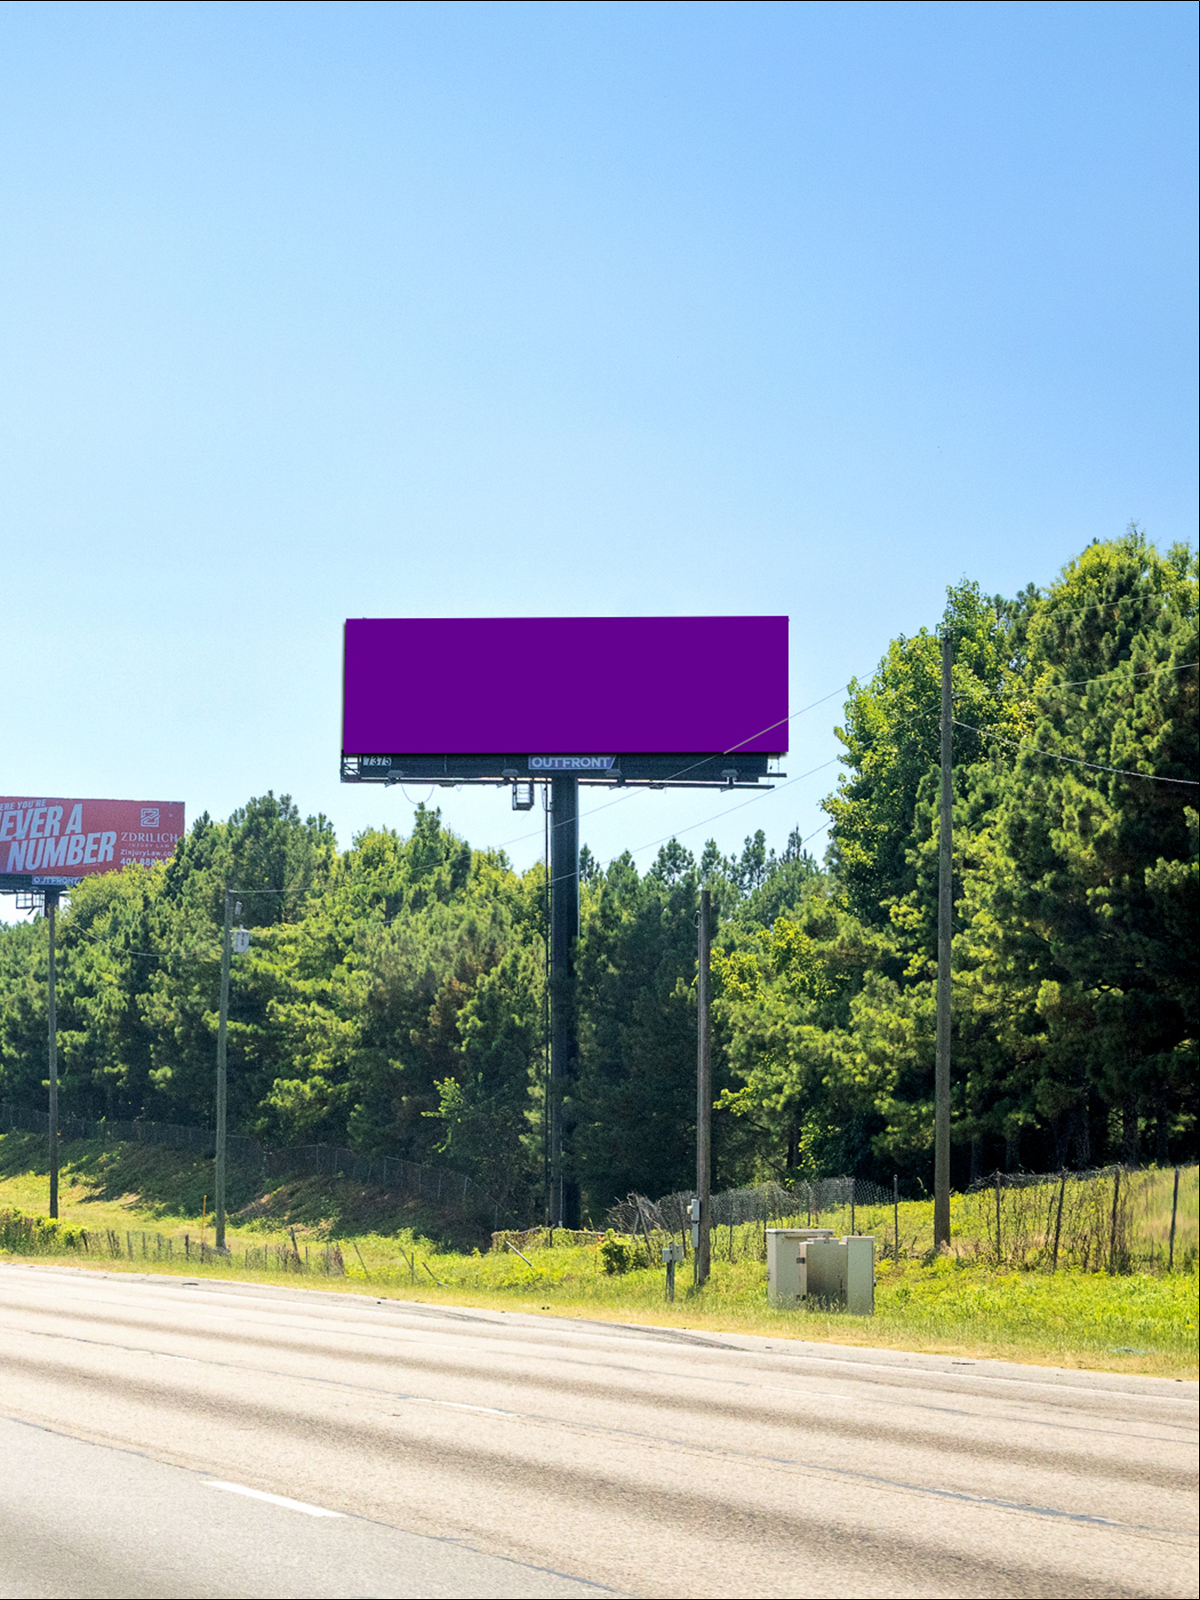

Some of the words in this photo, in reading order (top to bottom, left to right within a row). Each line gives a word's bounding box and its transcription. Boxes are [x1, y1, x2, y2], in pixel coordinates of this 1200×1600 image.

[366, 756, 391, 766] 7375
[532, 757, 611, 768] OUTFRONT
[17, 799, 46, 809] YOU'RE
[64, 803, 83, 834] A
[121, 832, 178, 843] ZDRILICH
[6, 831, 117, 873] NUMBER
